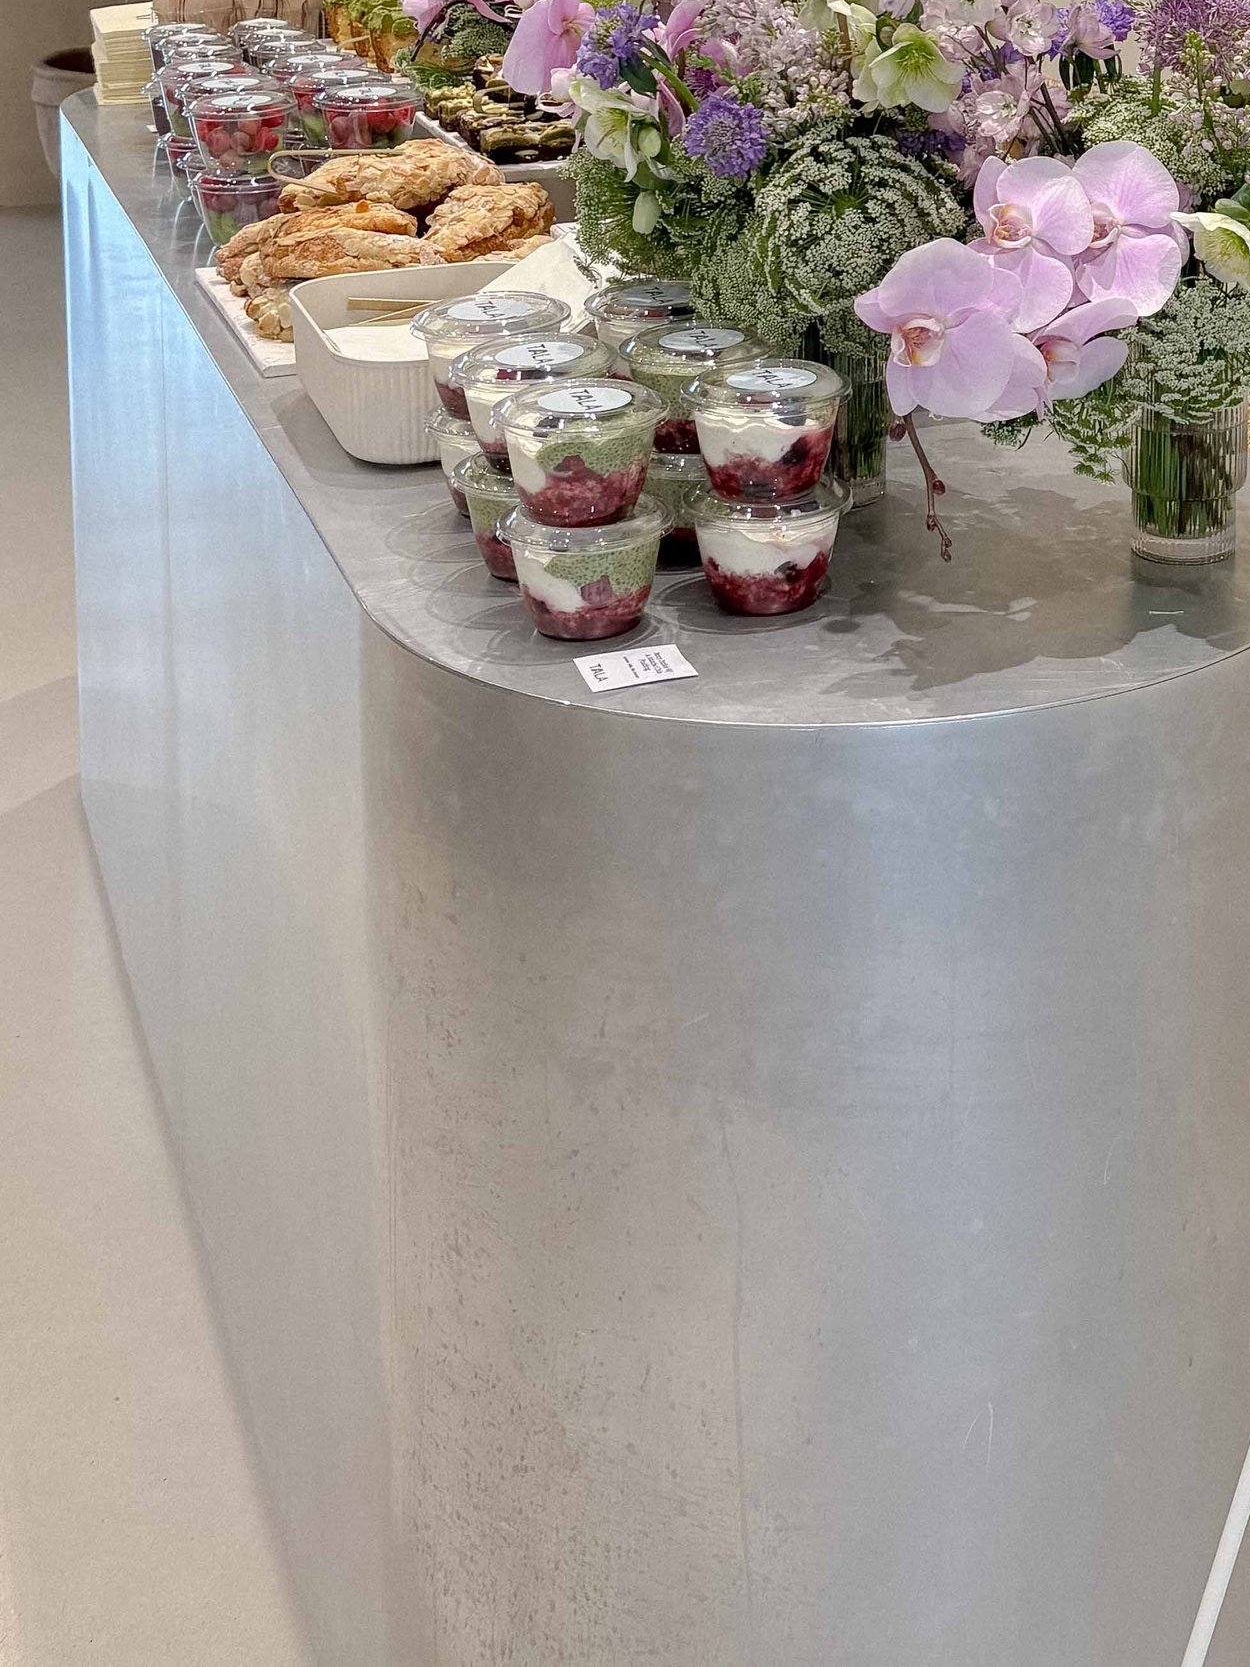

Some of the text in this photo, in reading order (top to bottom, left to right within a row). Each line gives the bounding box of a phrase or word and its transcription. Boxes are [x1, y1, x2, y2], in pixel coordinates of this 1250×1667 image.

[475, 301, 506, 318] TALA
[527, 343, 555, 364] TALA
[752, 370, 793, 388] TALA
[568, 389, 603, 410] TALA
[589, 663, 609, 683] TALA
